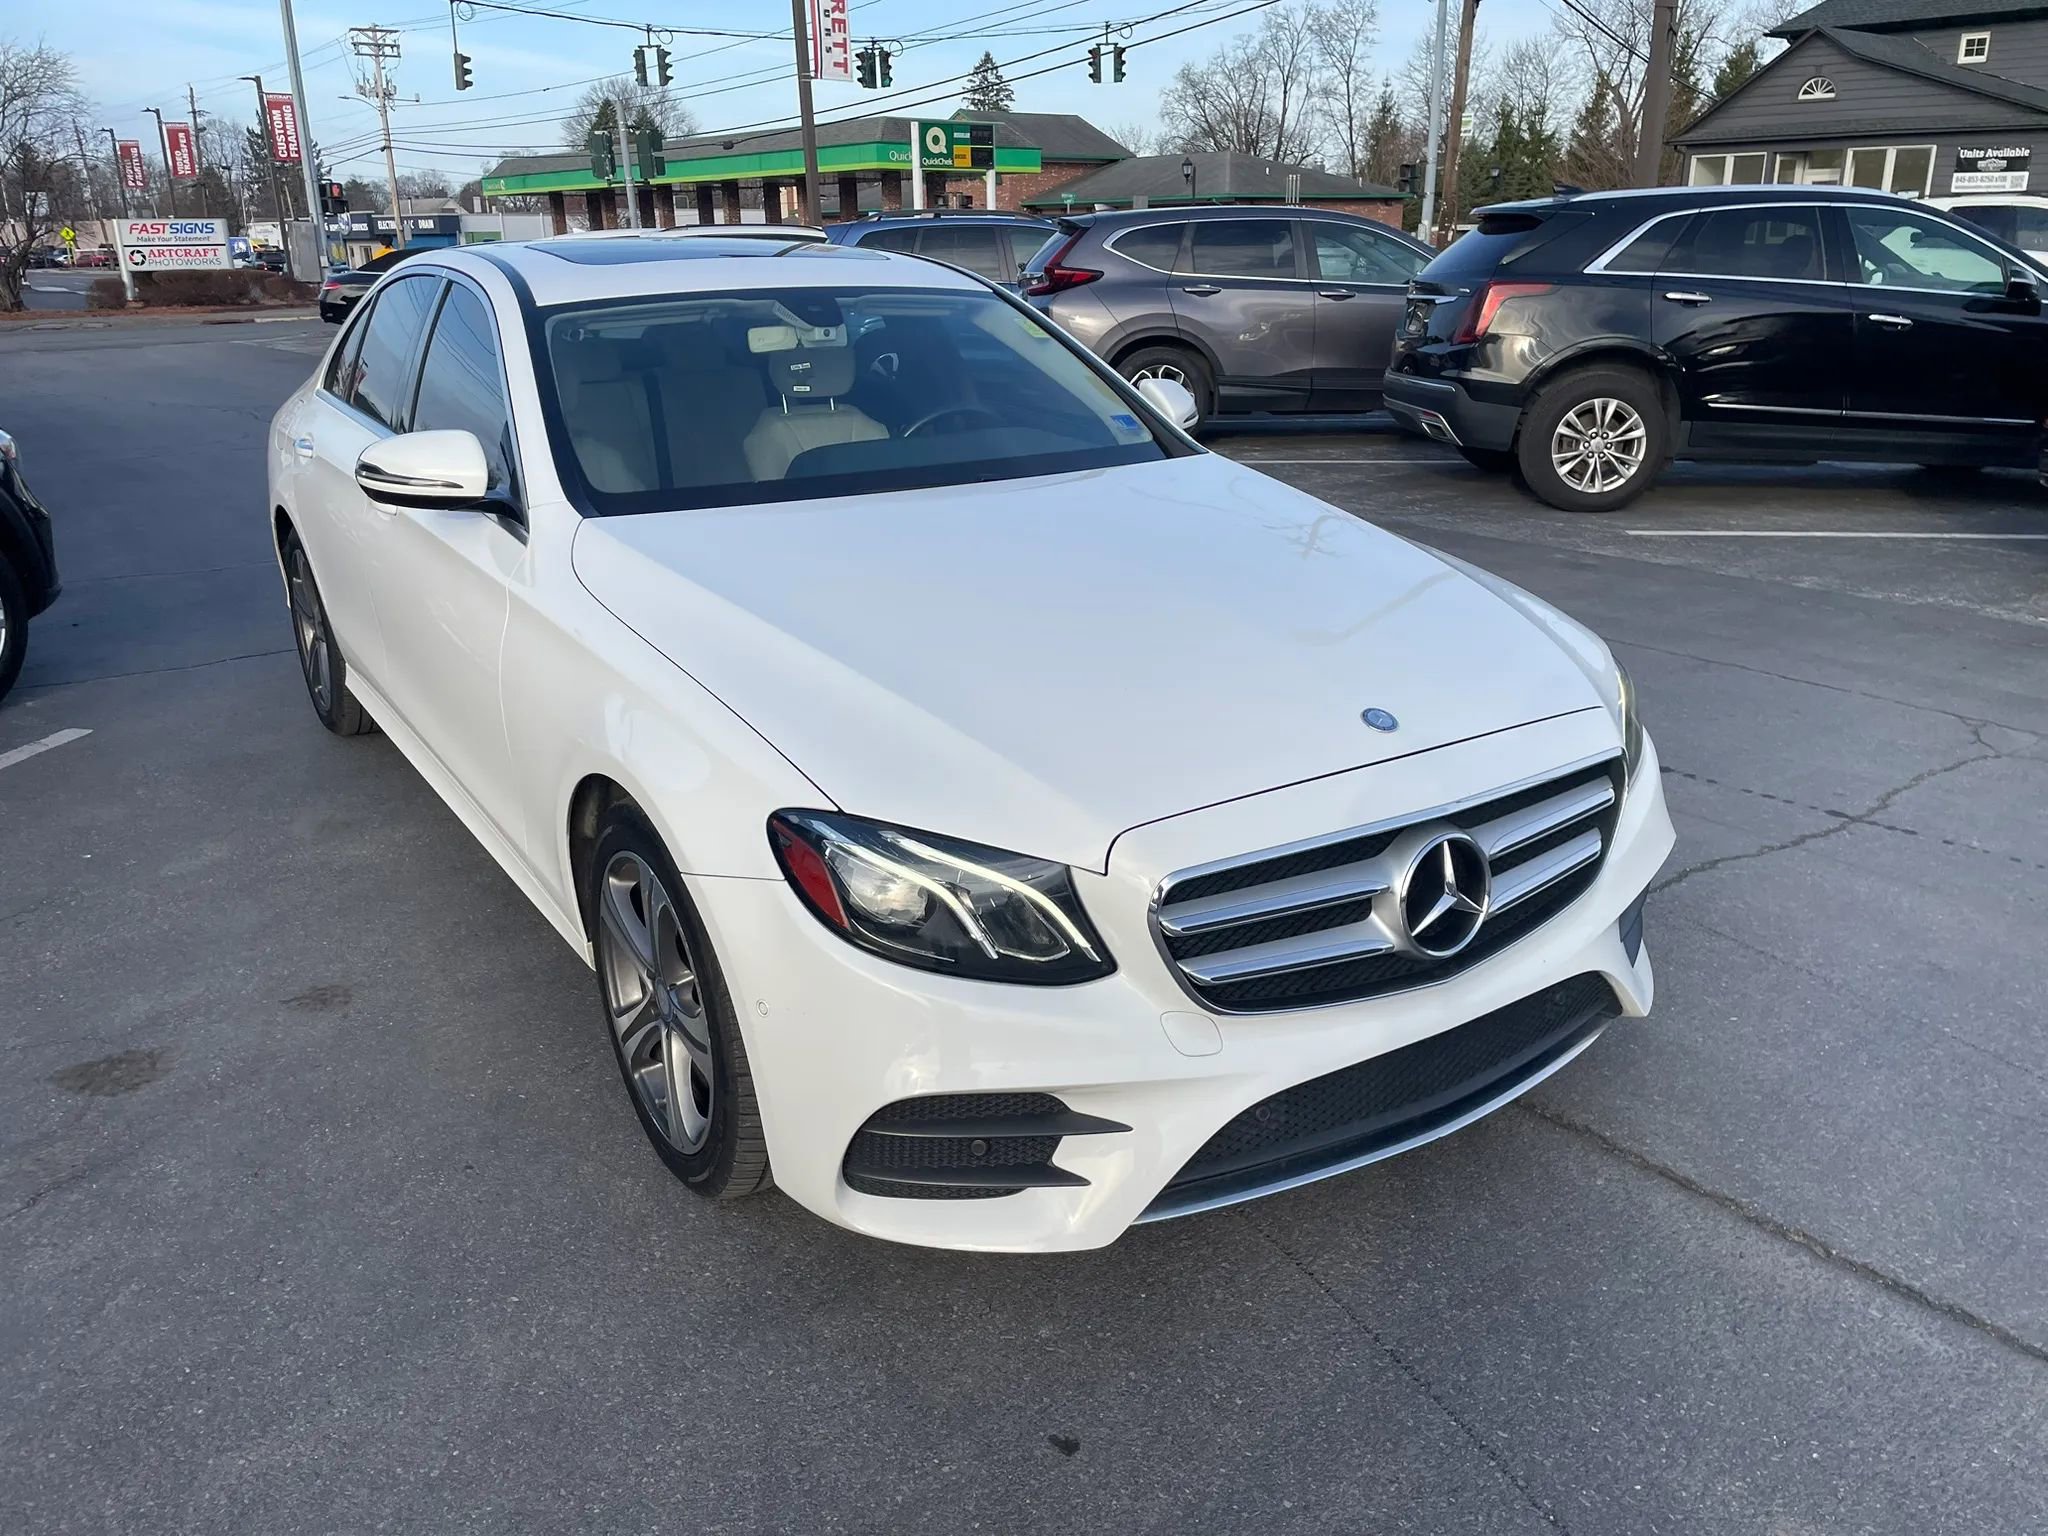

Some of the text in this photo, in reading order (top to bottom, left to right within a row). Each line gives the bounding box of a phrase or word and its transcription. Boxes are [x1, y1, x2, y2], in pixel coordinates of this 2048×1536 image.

[272, 109, 288, 158] CUSTOM
[282, 104, 299, 158] FRAMING
[178, 132, 192, 175] TRANSFER
[1959, 147, 2030, 158] Units Available
[174, 150, 184, 175] VIDEO
[922, 157, 953, 166] QuickChek
[129, 222, 215, 235] FASTSIGNS
[136, 235, 156, 243] Make
[148, 248, 219, 258] ARTCRAFT
[148, 257, 222, 267] PHOTOWORKS
